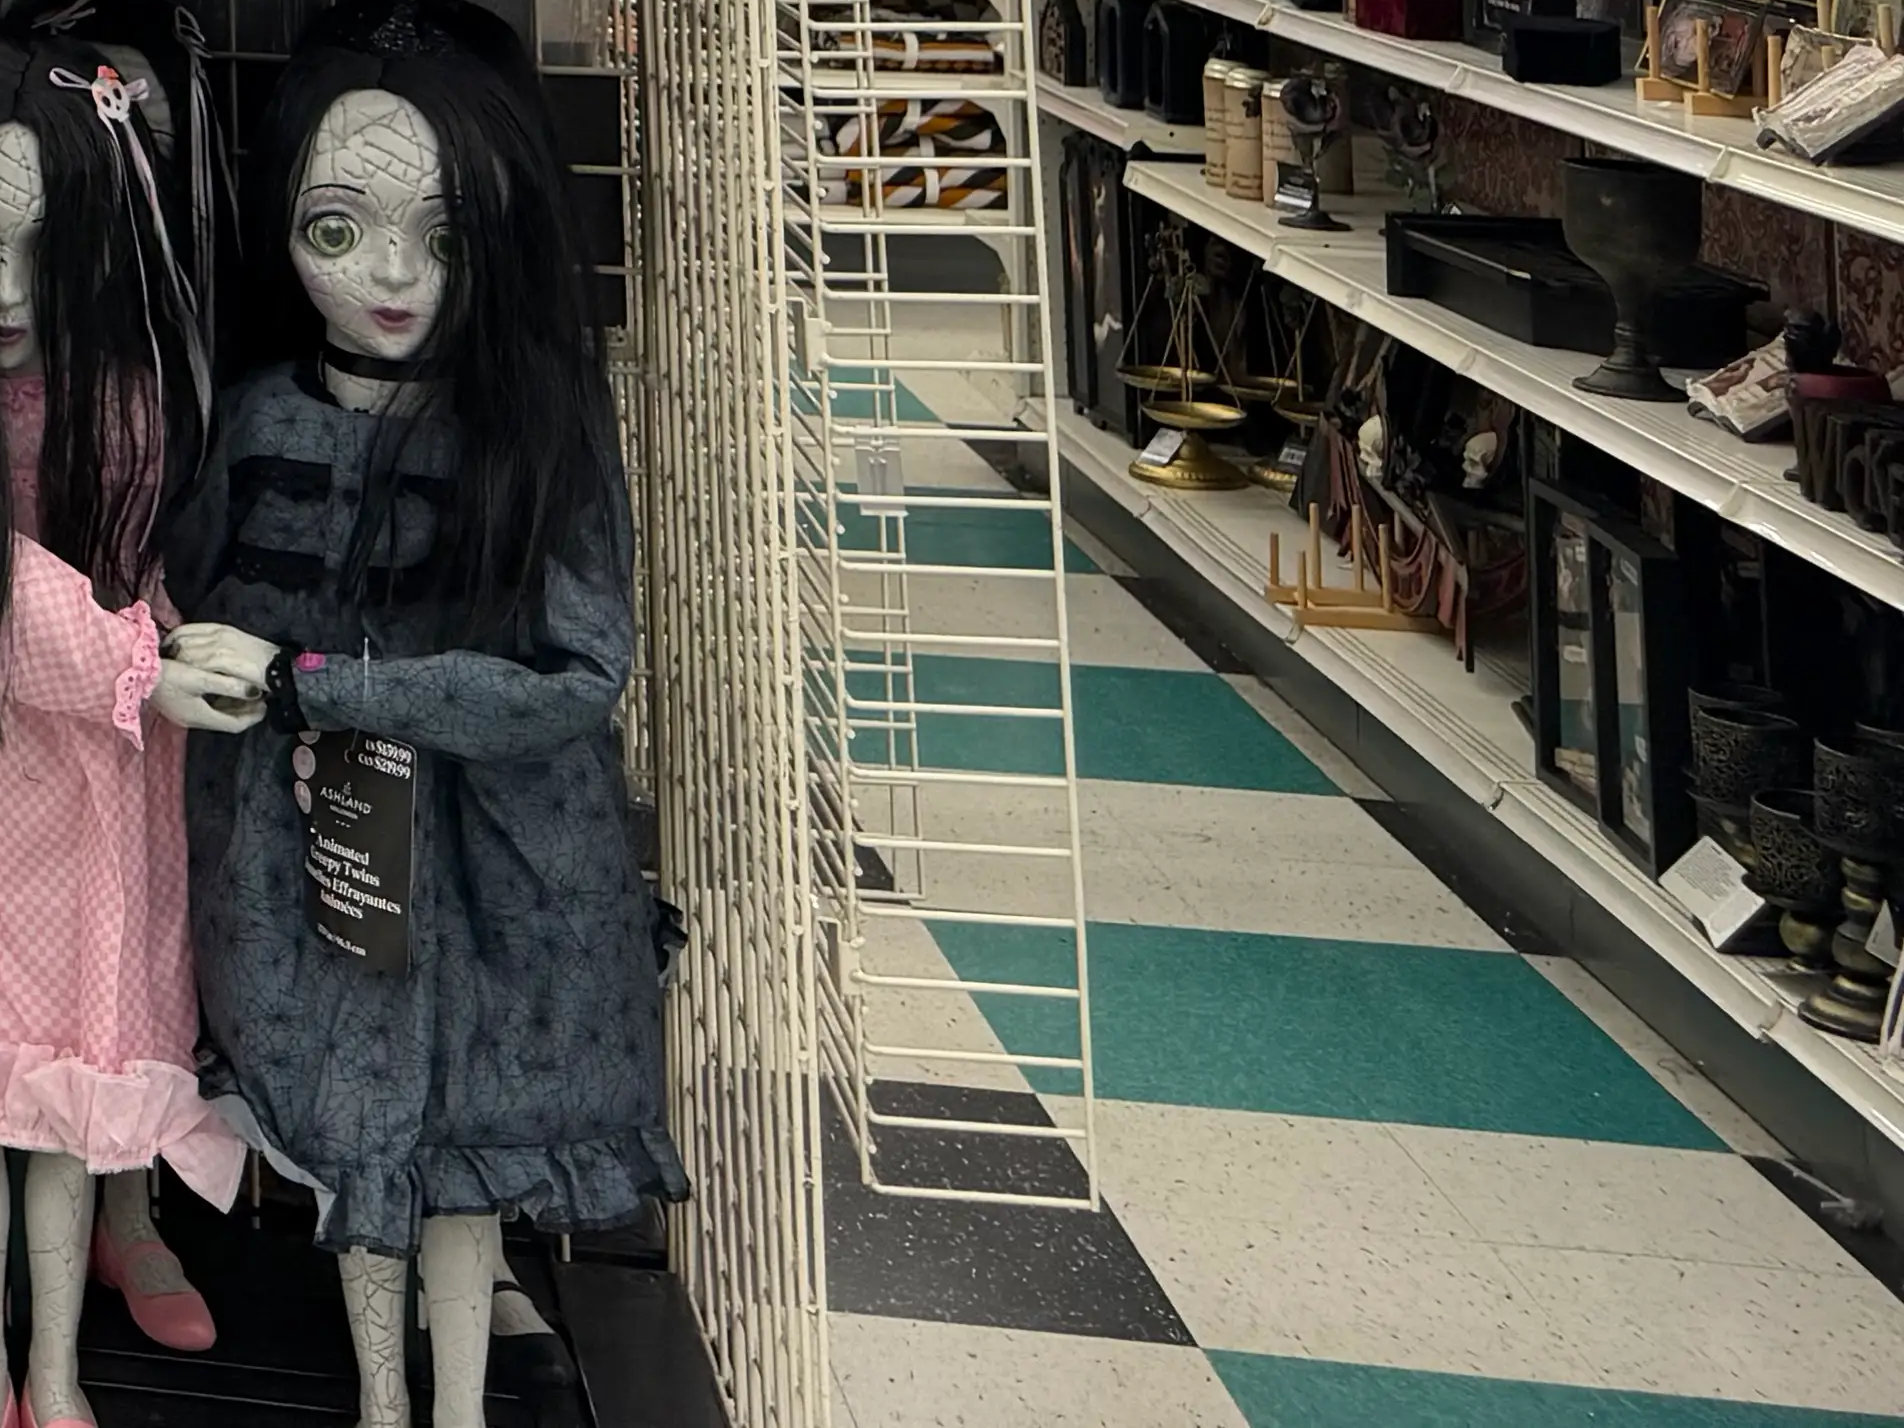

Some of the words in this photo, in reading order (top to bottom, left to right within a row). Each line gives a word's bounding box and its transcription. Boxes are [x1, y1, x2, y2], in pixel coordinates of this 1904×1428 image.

[320, 787, 371, 814] ASHLAND
[315, 833, 369, 866] Animated
[343, 860, 380, 887] Twins
[332, 877, 401, 914] Effrayantes
